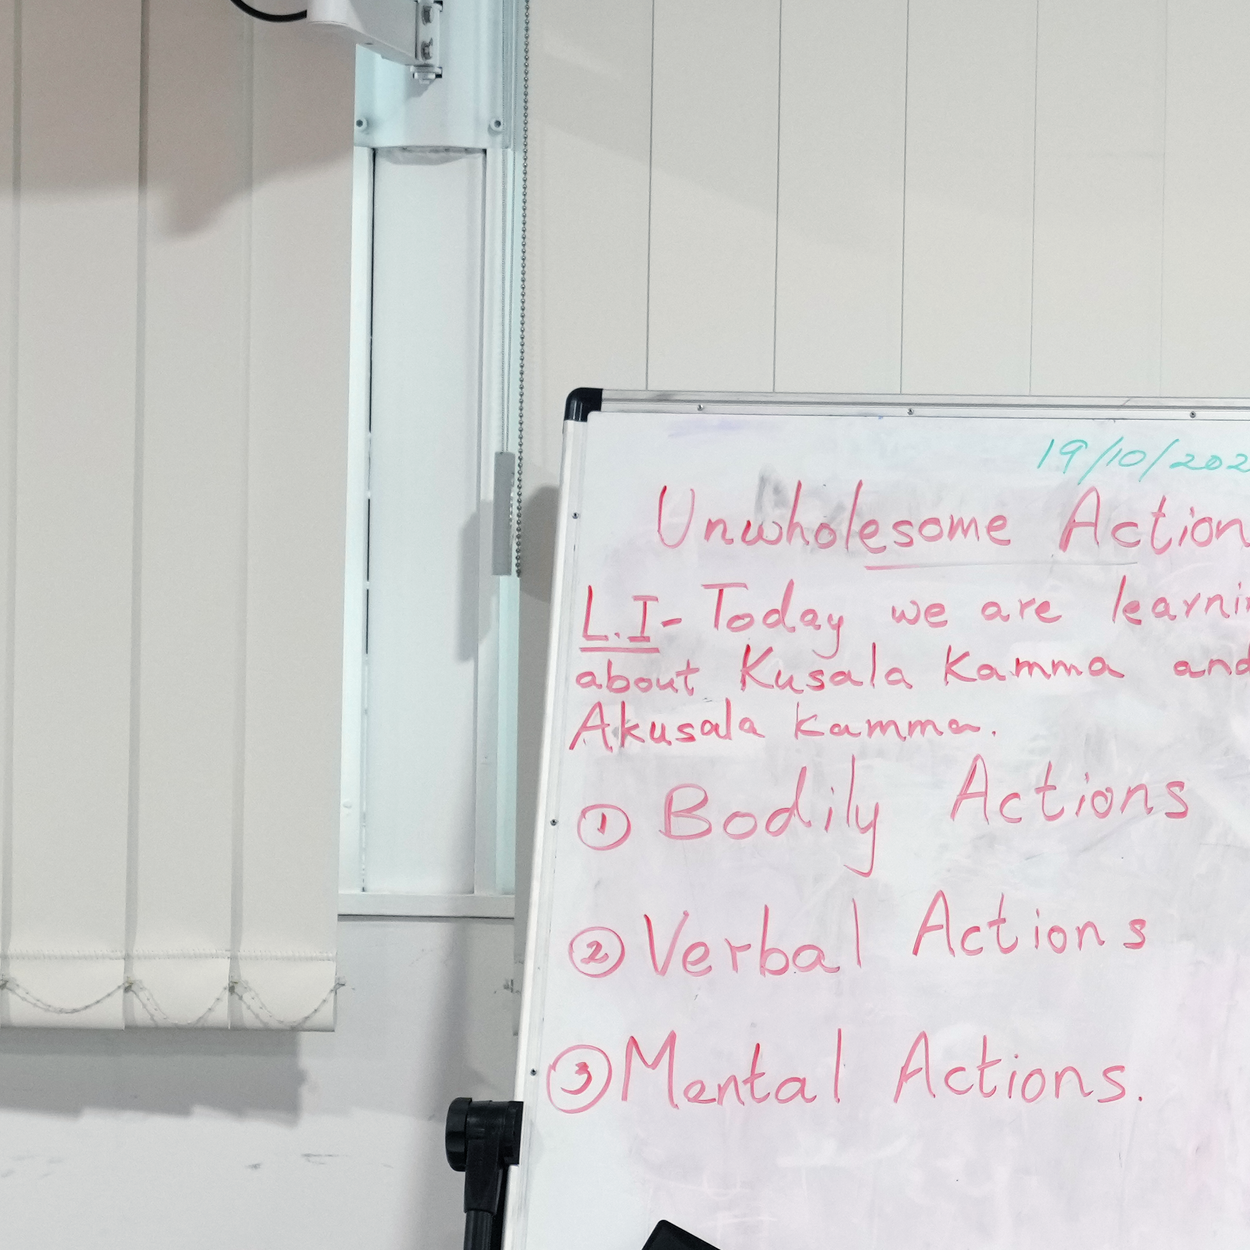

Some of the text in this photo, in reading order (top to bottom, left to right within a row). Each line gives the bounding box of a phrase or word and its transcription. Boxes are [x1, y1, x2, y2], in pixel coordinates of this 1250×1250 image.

[656, 478, 1012, 554] Unwholesome
[701, 578, 845, 660] Today
[891, 599, 949, 629] we
[981, 597, 1063, 624] are
[574, 658, 701, 697] about
[739, 641, 914, 695] Kusala
[568, 697, 767, 754] Akusala
[658, 753, 880, 878] Bodily
[949, 753, 1191, 824] Actions
[643, 898, 863, 978] Verbal
[911, 889, 1149, 958] Actions
[620, 1027, 844, 1110] Mental
[892, 1030, 1145, 1105] Actions.
